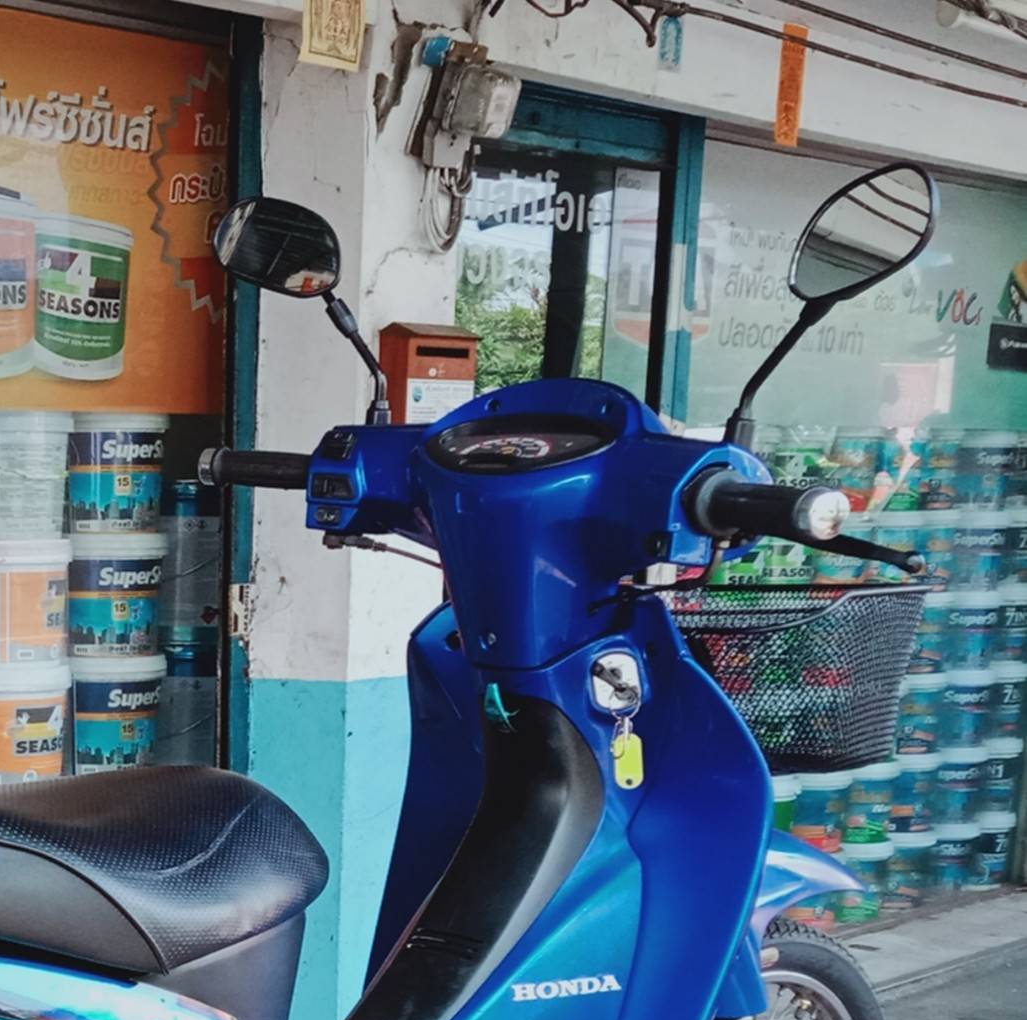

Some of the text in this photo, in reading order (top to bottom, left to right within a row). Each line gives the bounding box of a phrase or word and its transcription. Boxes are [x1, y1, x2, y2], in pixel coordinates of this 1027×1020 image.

[66, 251, 97, 298] 4
[38, 289, 120, 320] SEASONS
[116, 476, 131, 488] 15
[114, 602, 127, 613] 15
[123, 723, 135, 735] 15
[511, 974, 622, 1001] HONDA
